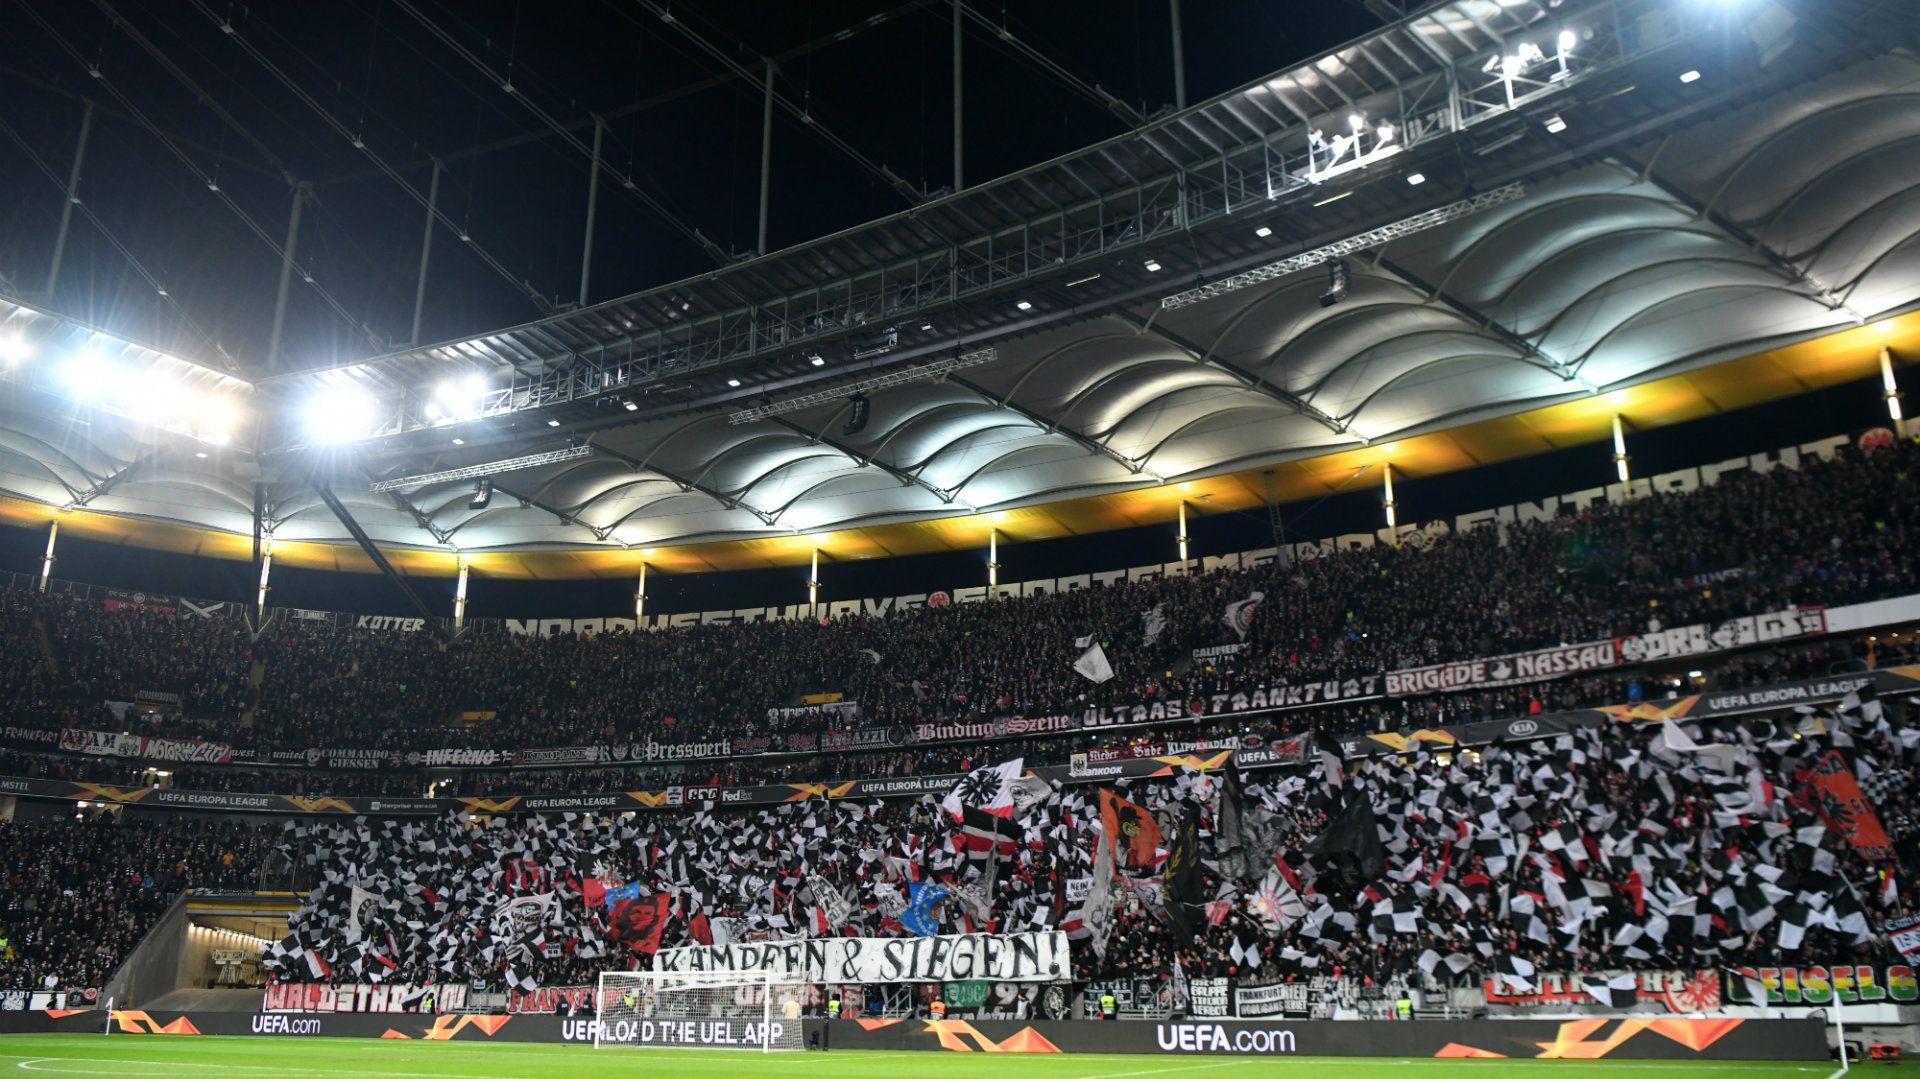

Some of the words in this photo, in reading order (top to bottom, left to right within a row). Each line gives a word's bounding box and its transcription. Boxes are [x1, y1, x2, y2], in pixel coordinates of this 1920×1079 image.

[1385, 663, 1486, 694] BRIGADE
[1516, 642, 1615, 678] NASSAU
[1083, 699, 1183, 726] ULTRAS
[1211, 675, 1379, 713] FRANKFURT
[1709, 694, 1749, 710] UEFA
[1750, 686, 1808, 705] EUROPA
[322, 749, 388, 759] COMMANDO
[861, 782, 886, 793] UEFA
[887, 779, 921, 791] EUROPA
[158, 793, 185, 803] UEFA
[187, 794, 226, 805] EUROPA
[229, 796, 269, 807] LEAGUE
[526, 799, 548, 808] UEFA
[549, 798, 582, 808] EUROPA
[583, 797, 616, 807] LEAGUE
[841, 938, 862, 982] &
[251, 1015, 321, 1034] UEFA.com
[659, 1021, 695, 1043] THE
[701, 1022, 737, 1044] UEL
[1157, 1024, 1297, 1053] UEFA.com
